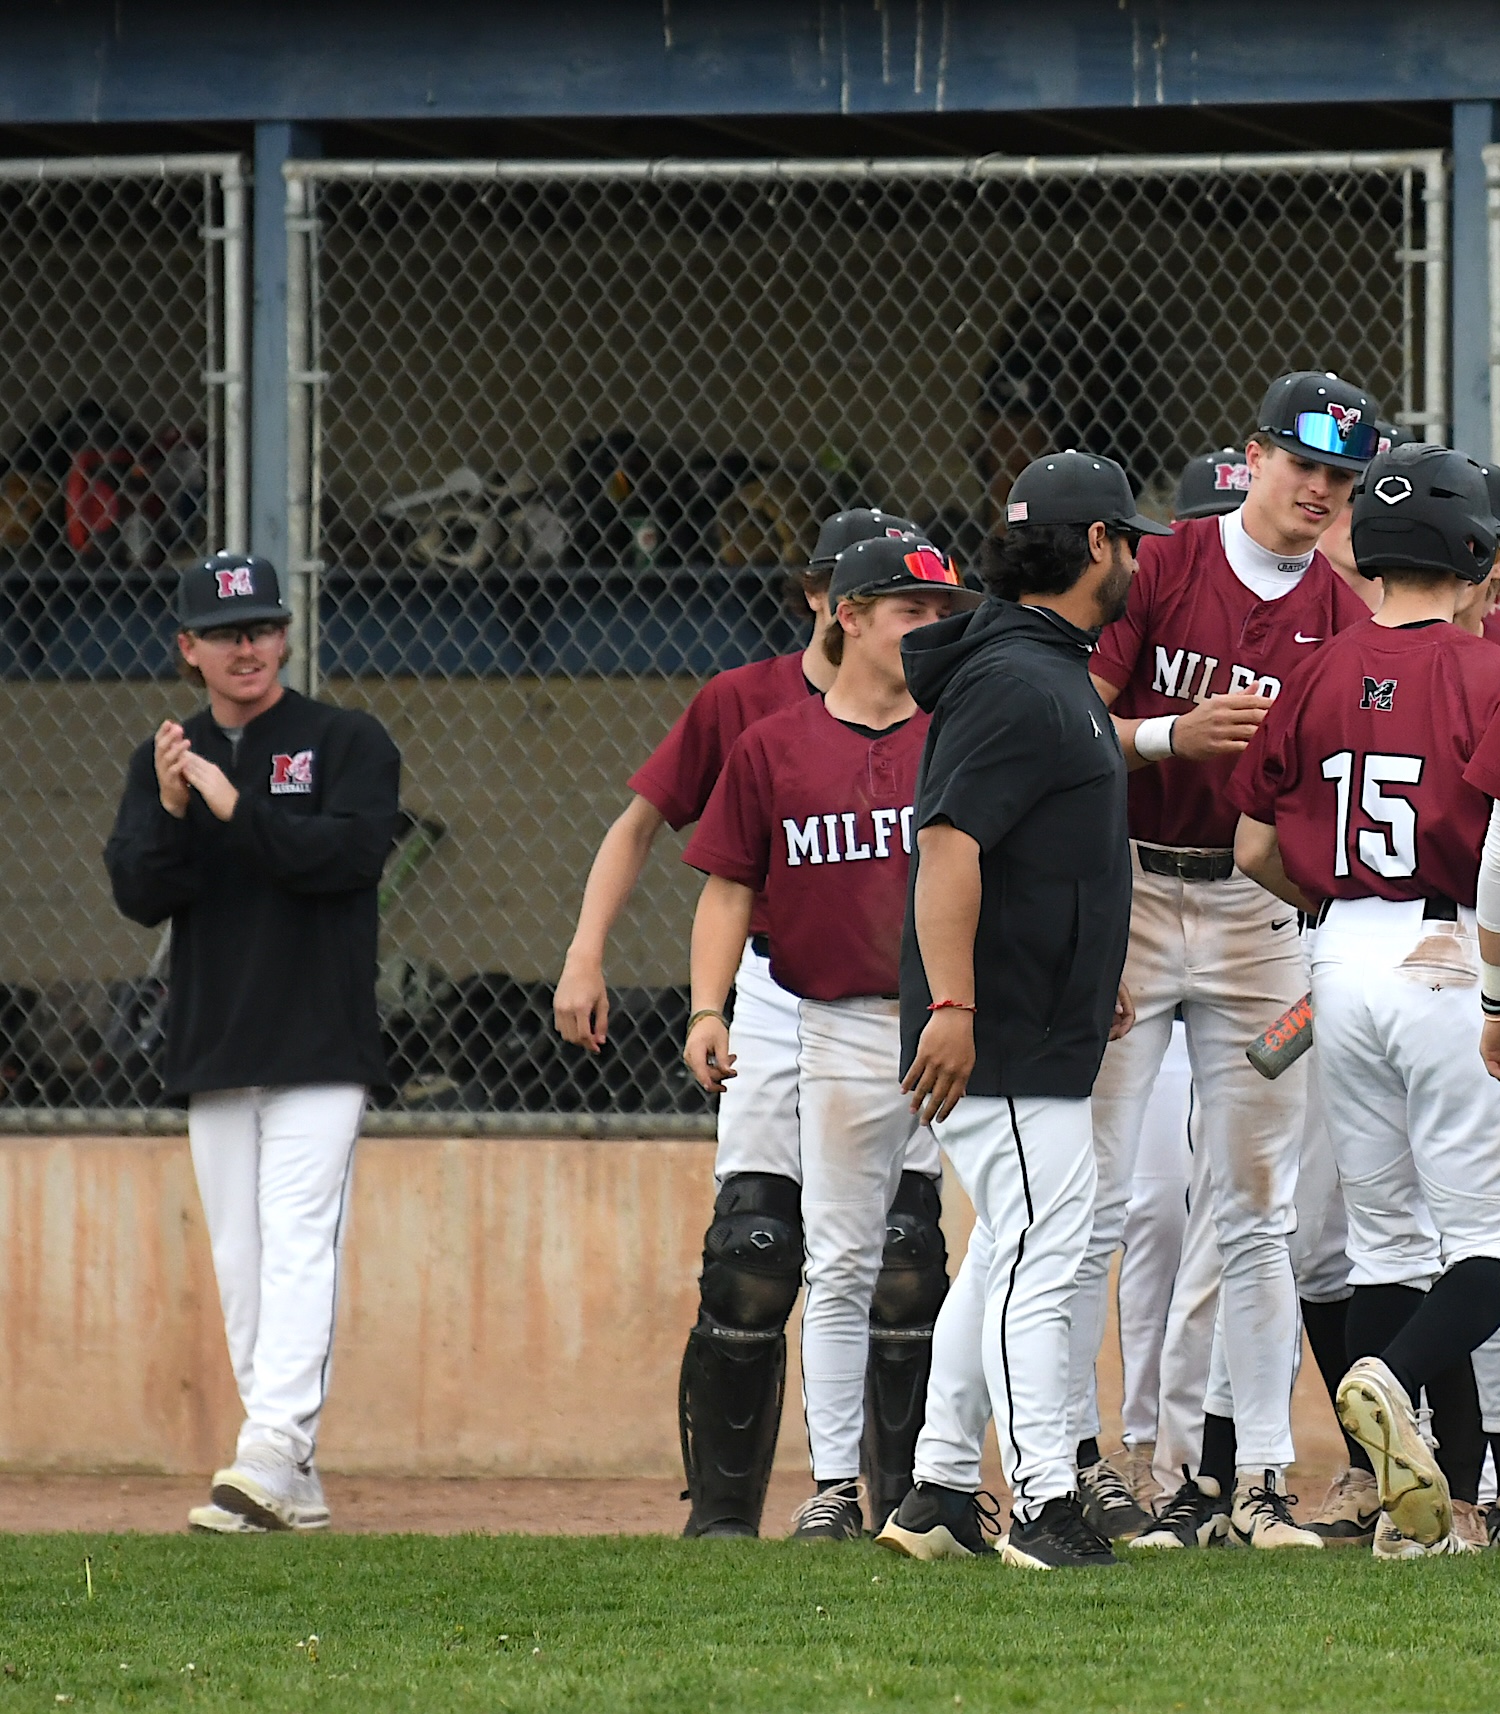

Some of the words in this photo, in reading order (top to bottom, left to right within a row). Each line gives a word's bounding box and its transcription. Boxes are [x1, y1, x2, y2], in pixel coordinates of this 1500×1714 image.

[215, 567, 253, 598] M
[1360, 676, 1397, 711] M
[270, 750, 313, 784] M
[1320, 749, 1425, 879] 15
